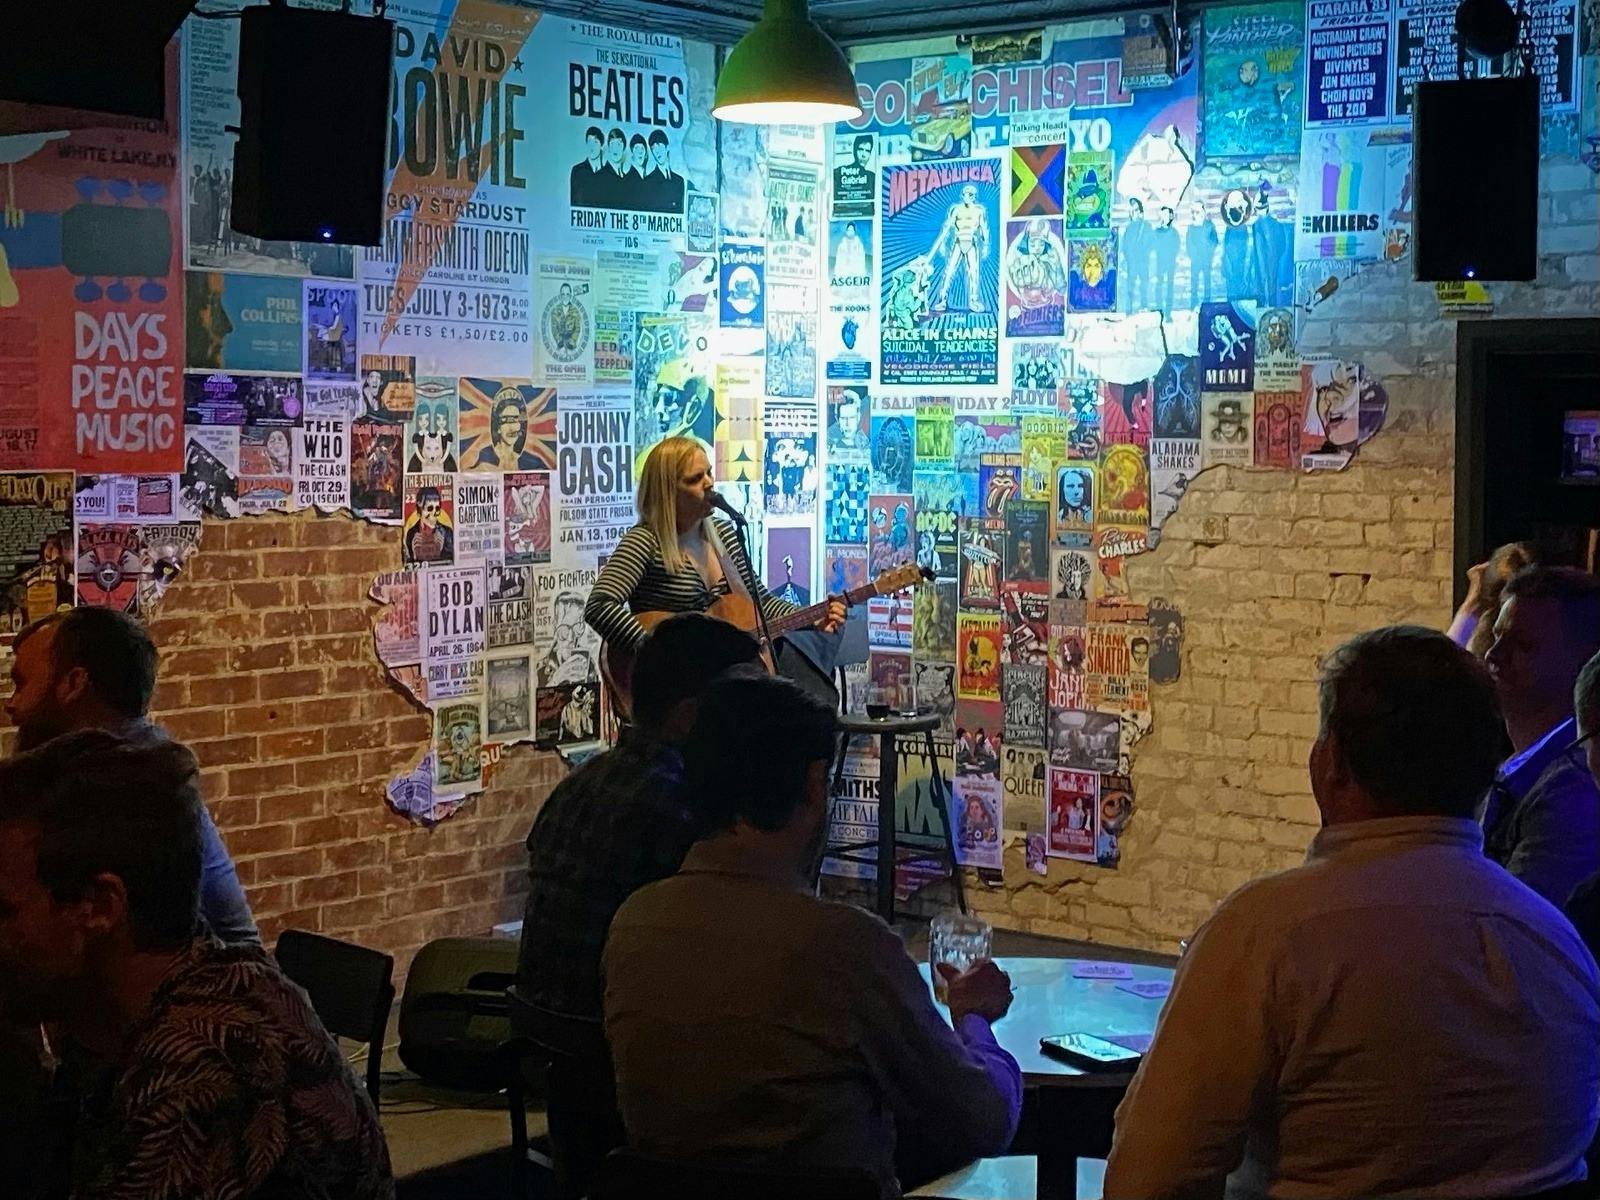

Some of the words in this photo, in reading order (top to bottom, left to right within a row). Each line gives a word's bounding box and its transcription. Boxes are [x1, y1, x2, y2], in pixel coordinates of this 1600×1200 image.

[580, 23, 605, 37] THE
[607, 28, 643, 44] ROYAL
[645, 33, 673, 49] HALL
[1312, 29, 1357, 46] AUSTRALIAN
[396, 26, 506, 73] DAVID
[596, 48, 609, 64] THE
[611, 51, 658, 70] SENSATIONAL
[1314, 45, 1345, 60] MOVING
[1346, 41, 1382, 57] PICTURES
[971, 58, 1134, 120] CHISEL
[1320, 75, 1338, 89] JON
[1340, 72, 1376, 88] ENGLISH
[569, 62, 684, 129] BEATLES
[1327, 103, 1343, 118] THE
[389, 66, 527, 189] OWIE
[1012, 121, 1041, 134] Talking
[1042, 120, 1067, 132] Heads
[1028, 131, 1066, 143] concert
[475, 191, 488, 200] AS
[887, 164, 995, 222] METALLICA
[386, 192, 424, 212] GGY
[430, 199, 526, 224] STARDUST
[571, 209, 607, 229] FRIDAY
[610, 212, 629, 230] THE
[1312, 213, 1380, 234] KILLERS
[484, 229, 529, 276] ODEON
[266, 296, 298, 310] PHIL
[458, 292, 510, 321] 3-1973
[241, 308, 300, 323] COLLINS
[74, 310, 168, 362] DAYS
[363, 321, 433, 337] TICKETS
[883, 328, 920, 340] ALICE
[944, 327, 998, 340] CHAINS
[594, 341, 617, 352] LED
[883, 340, 928, 353] SUICIDAL
[934, 340, 997, 353] TENDENCIES
[71, 363, 176, 410] PEACE
[1011, 389, 1058, 406] FLOYD
[76, 411, 175, 455] MUSIC
[304, 421, 343, 432] THE
[559, 411, 631, 445] JOHNNY
[303, 434, 343, 458] WHO
[300, 463, 316, 476] THE
[318, 463, 346, 476] CLASH
[560, 445, 633, 496] CASH
[1158, 456, 1194, 469] SHAKES
[328, 481, 343, 493] 29
[405, 475, 420, 488] THE
[420, 474, 452, 487] STROKES
[83, 496, 105, 508] YOU!
[300, 493, 345, 504] COLISEUM
[459, 486, 493, 504] SIMON
[458, 504, 499, 524] GARFUNKEL
[560, 508, 587, 522] FOLSOM
[588, 507, 608, 519] STATE
[610, 506, 633, 518] PRISON
[1101, 527, 1128, 544] Ray
[1098, 539, 1145, 559] CHARLES
[538, 575, 556, 590] FOO
[558, 570, 597, 589] FIGHTERS
[440, 580, 473, 608] BOB
[429, 606, 484, 637] DYLAN
[489, 602, 503, 624] THE
[506, 600, 532, 621] CLASH
[430, 645, 451, 658] APRIL
[467, 641, 485, 653] 1964
[1090, 632, 1127, 647] FRANK
[1087, 645, 1131, 677] SINATRA
[1050, 669, 1086, 694] JANI
[1004, 776, 1044, 797] QUEEN
